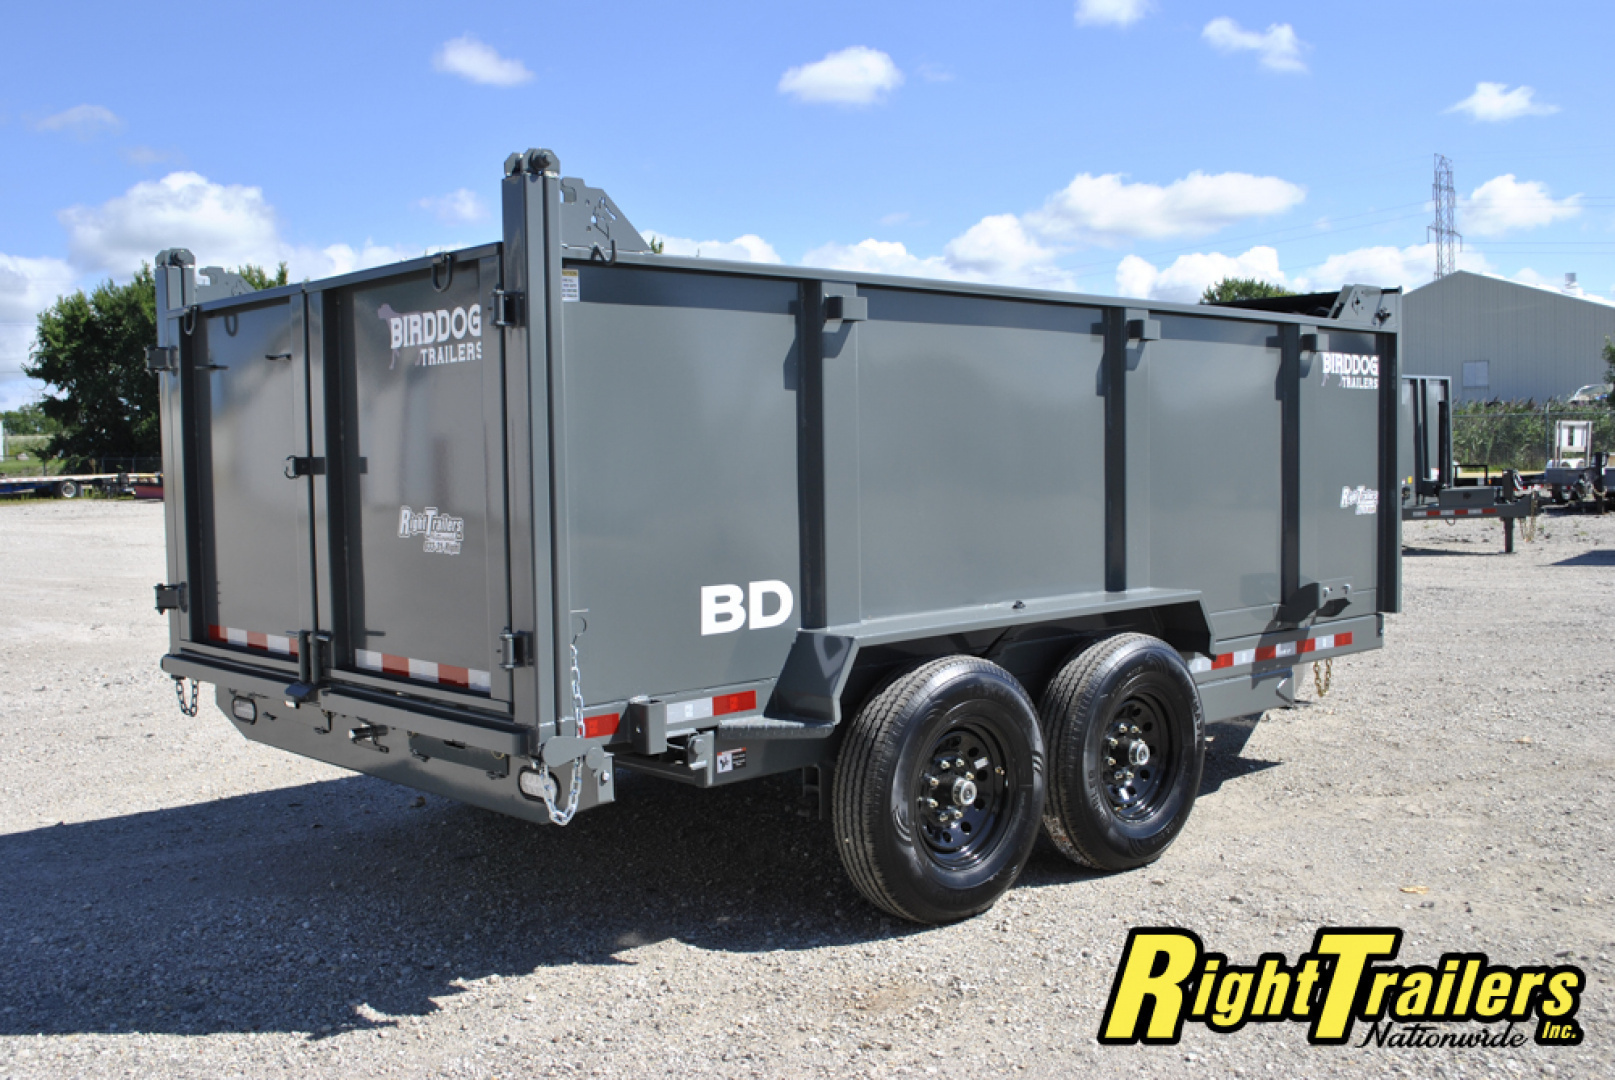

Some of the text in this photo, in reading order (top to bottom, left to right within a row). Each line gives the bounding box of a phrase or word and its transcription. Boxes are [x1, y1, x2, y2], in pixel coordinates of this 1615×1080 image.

[391, 304, 481, 349] BIRDDOG
[1322, 352, 1378, 376] BIRDDOG
[1342, 376, 1378, 389] TRAILERS
[701, 580, 793, 636] BD
